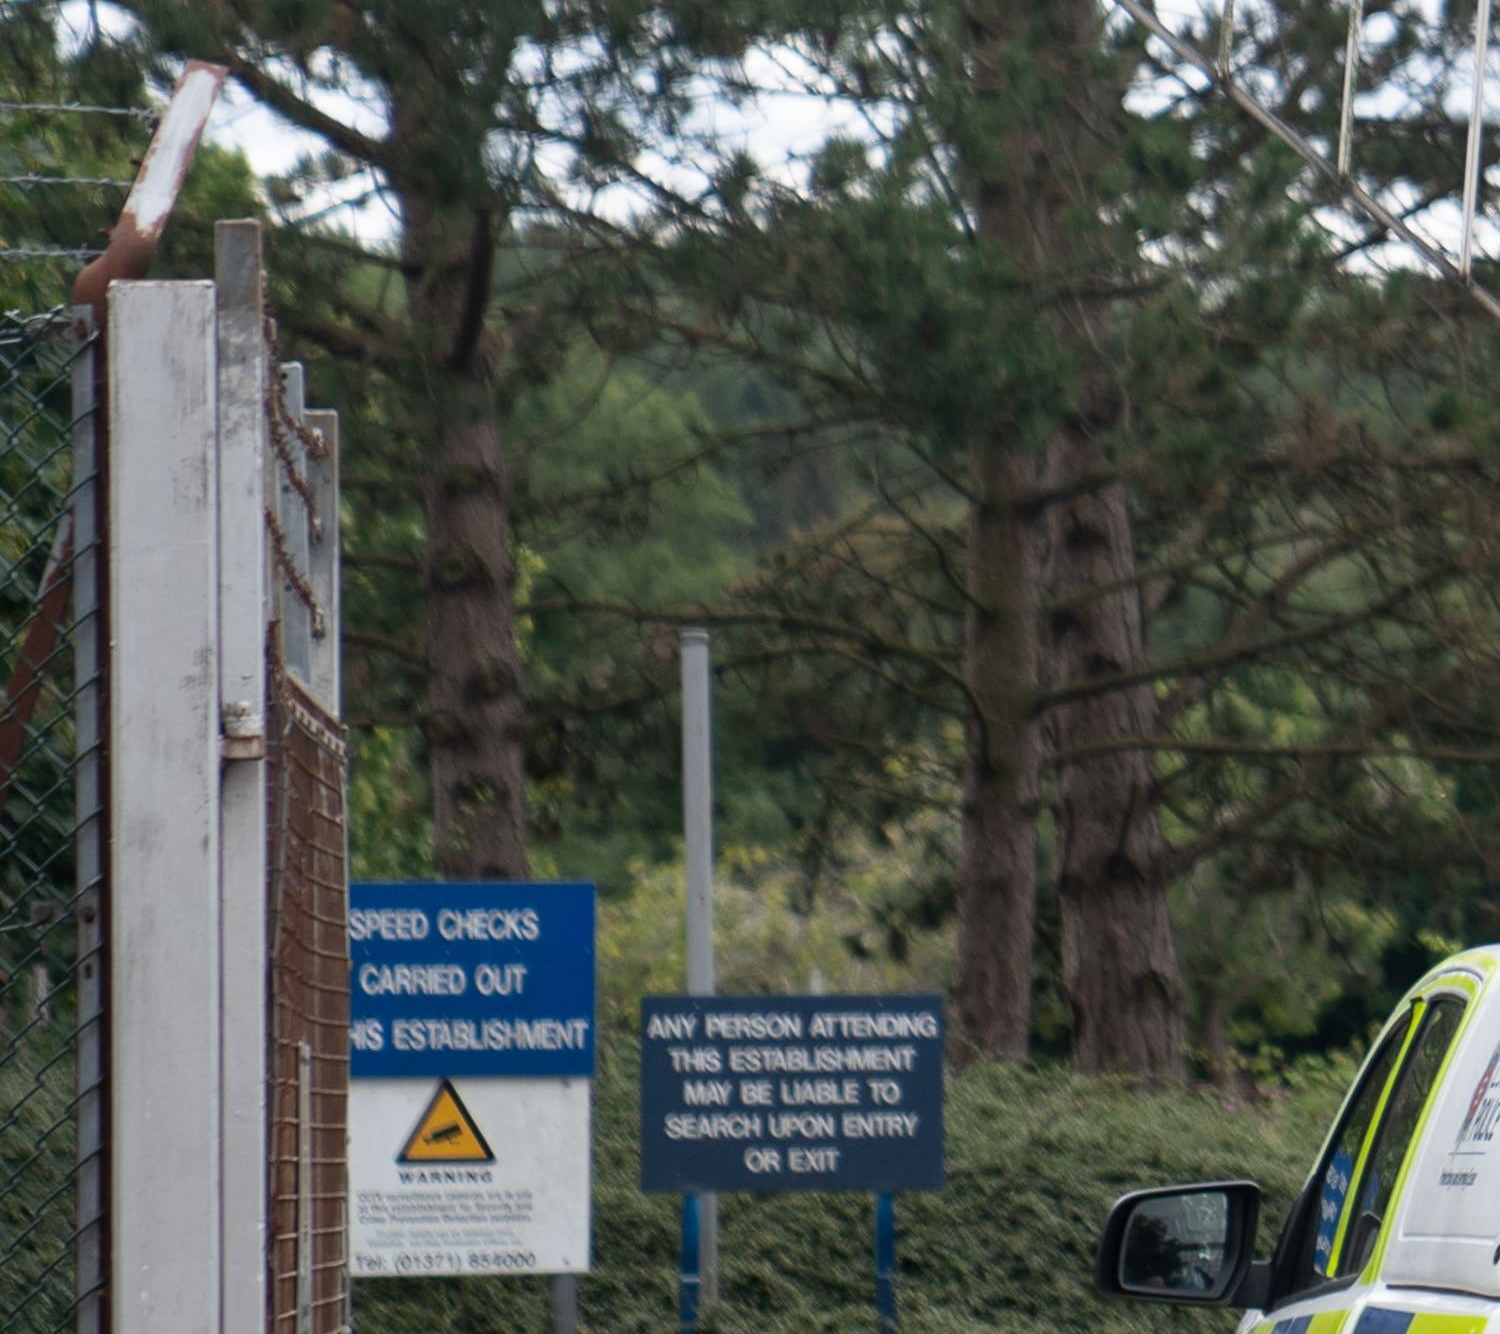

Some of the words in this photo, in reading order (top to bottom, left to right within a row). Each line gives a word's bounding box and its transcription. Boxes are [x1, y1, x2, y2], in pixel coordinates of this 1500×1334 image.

[349, 908, 429, 940] SPEED
[437, 908, 540, 940] CHECKS
[359, 963, 466, 996] CARRIED
[474, 963, 527, 996] OUT
[348, 1018, 384, 1051] HIS
[392, 1018, 589, 1051] ESTABLISHMENT
[647, 1014, 697, 1039] ANY
[704, 1012, 801, 1039] PERSON
[808, 1012, 938, 1039] ATTENDING
[668, 1046, 721, 1073] THIS
[728, 1046, 916, 1072] ESTABLISHMENT
[683, 1079, 732, 1106] MAY
[740, 1080, 773, 1106] BE
[780, 1079, 860, 1105] LIABLE
[868, 1079, 902, 1105] TO
[664, 1113, 761, 1139] SEARCH
[768, 1113, 835, 1138] UPON
[841, 1113, 918, 1138] ENTRY
[744, 1147, 781, 1173] OR
[787, 1147, 840, 1173] EXIT
[399, 1170, 493, 1185] WARNING
